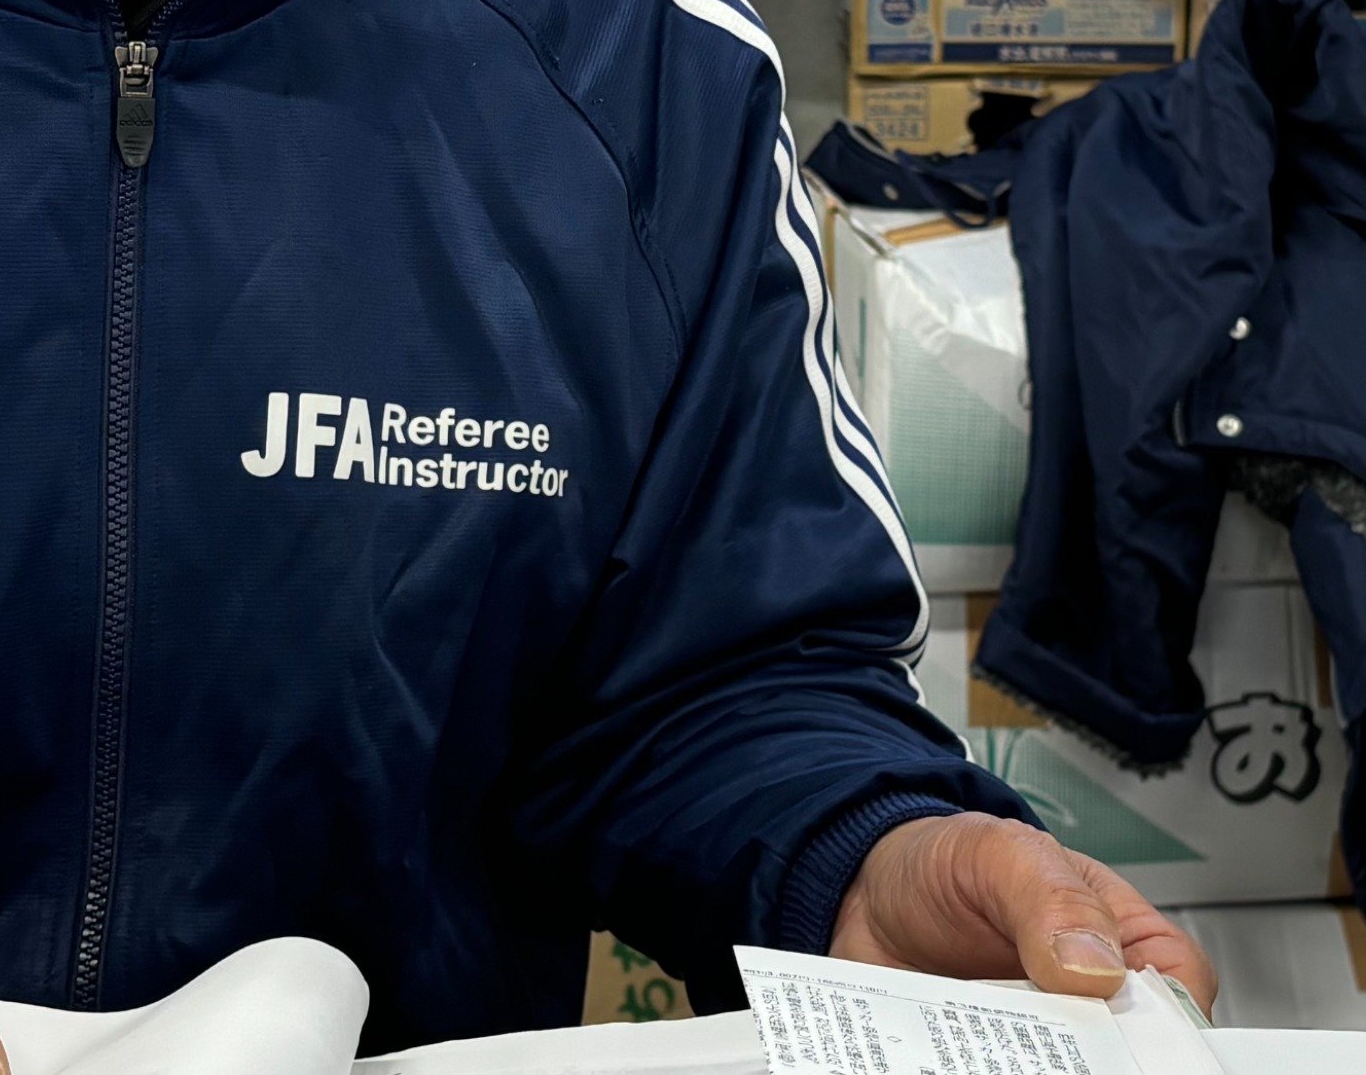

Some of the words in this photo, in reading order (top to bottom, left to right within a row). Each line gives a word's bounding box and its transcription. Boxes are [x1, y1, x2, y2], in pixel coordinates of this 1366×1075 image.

[241, 392, 375, 484] JFA
[382, 403, 551, 452] Referee
[378, 448, 569, 499] Instructor
